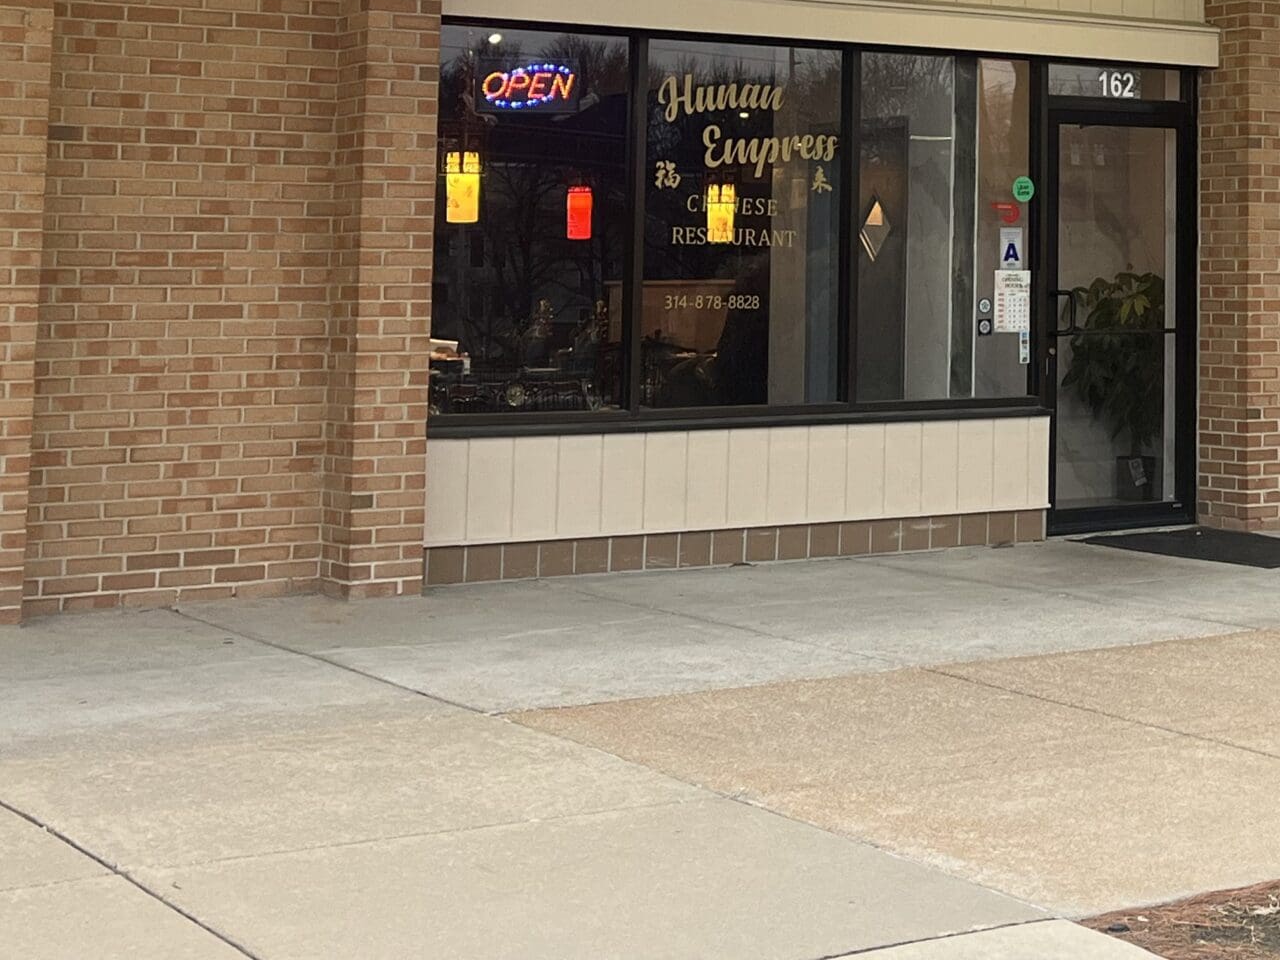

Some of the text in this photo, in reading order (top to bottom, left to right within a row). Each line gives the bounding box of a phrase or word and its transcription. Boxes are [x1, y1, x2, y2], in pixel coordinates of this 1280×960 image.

[481, 71, 576, 100] OPEN
[657, 74, 785, 123] Hunan
[1099, 71, 1134, 98] 162
[702, 124, 839, 178] Empress
[654, 159, 682, 189] 福
[1003, 243, 1020, 261] A
[664, 295, 760, 309] 314-878-8828
